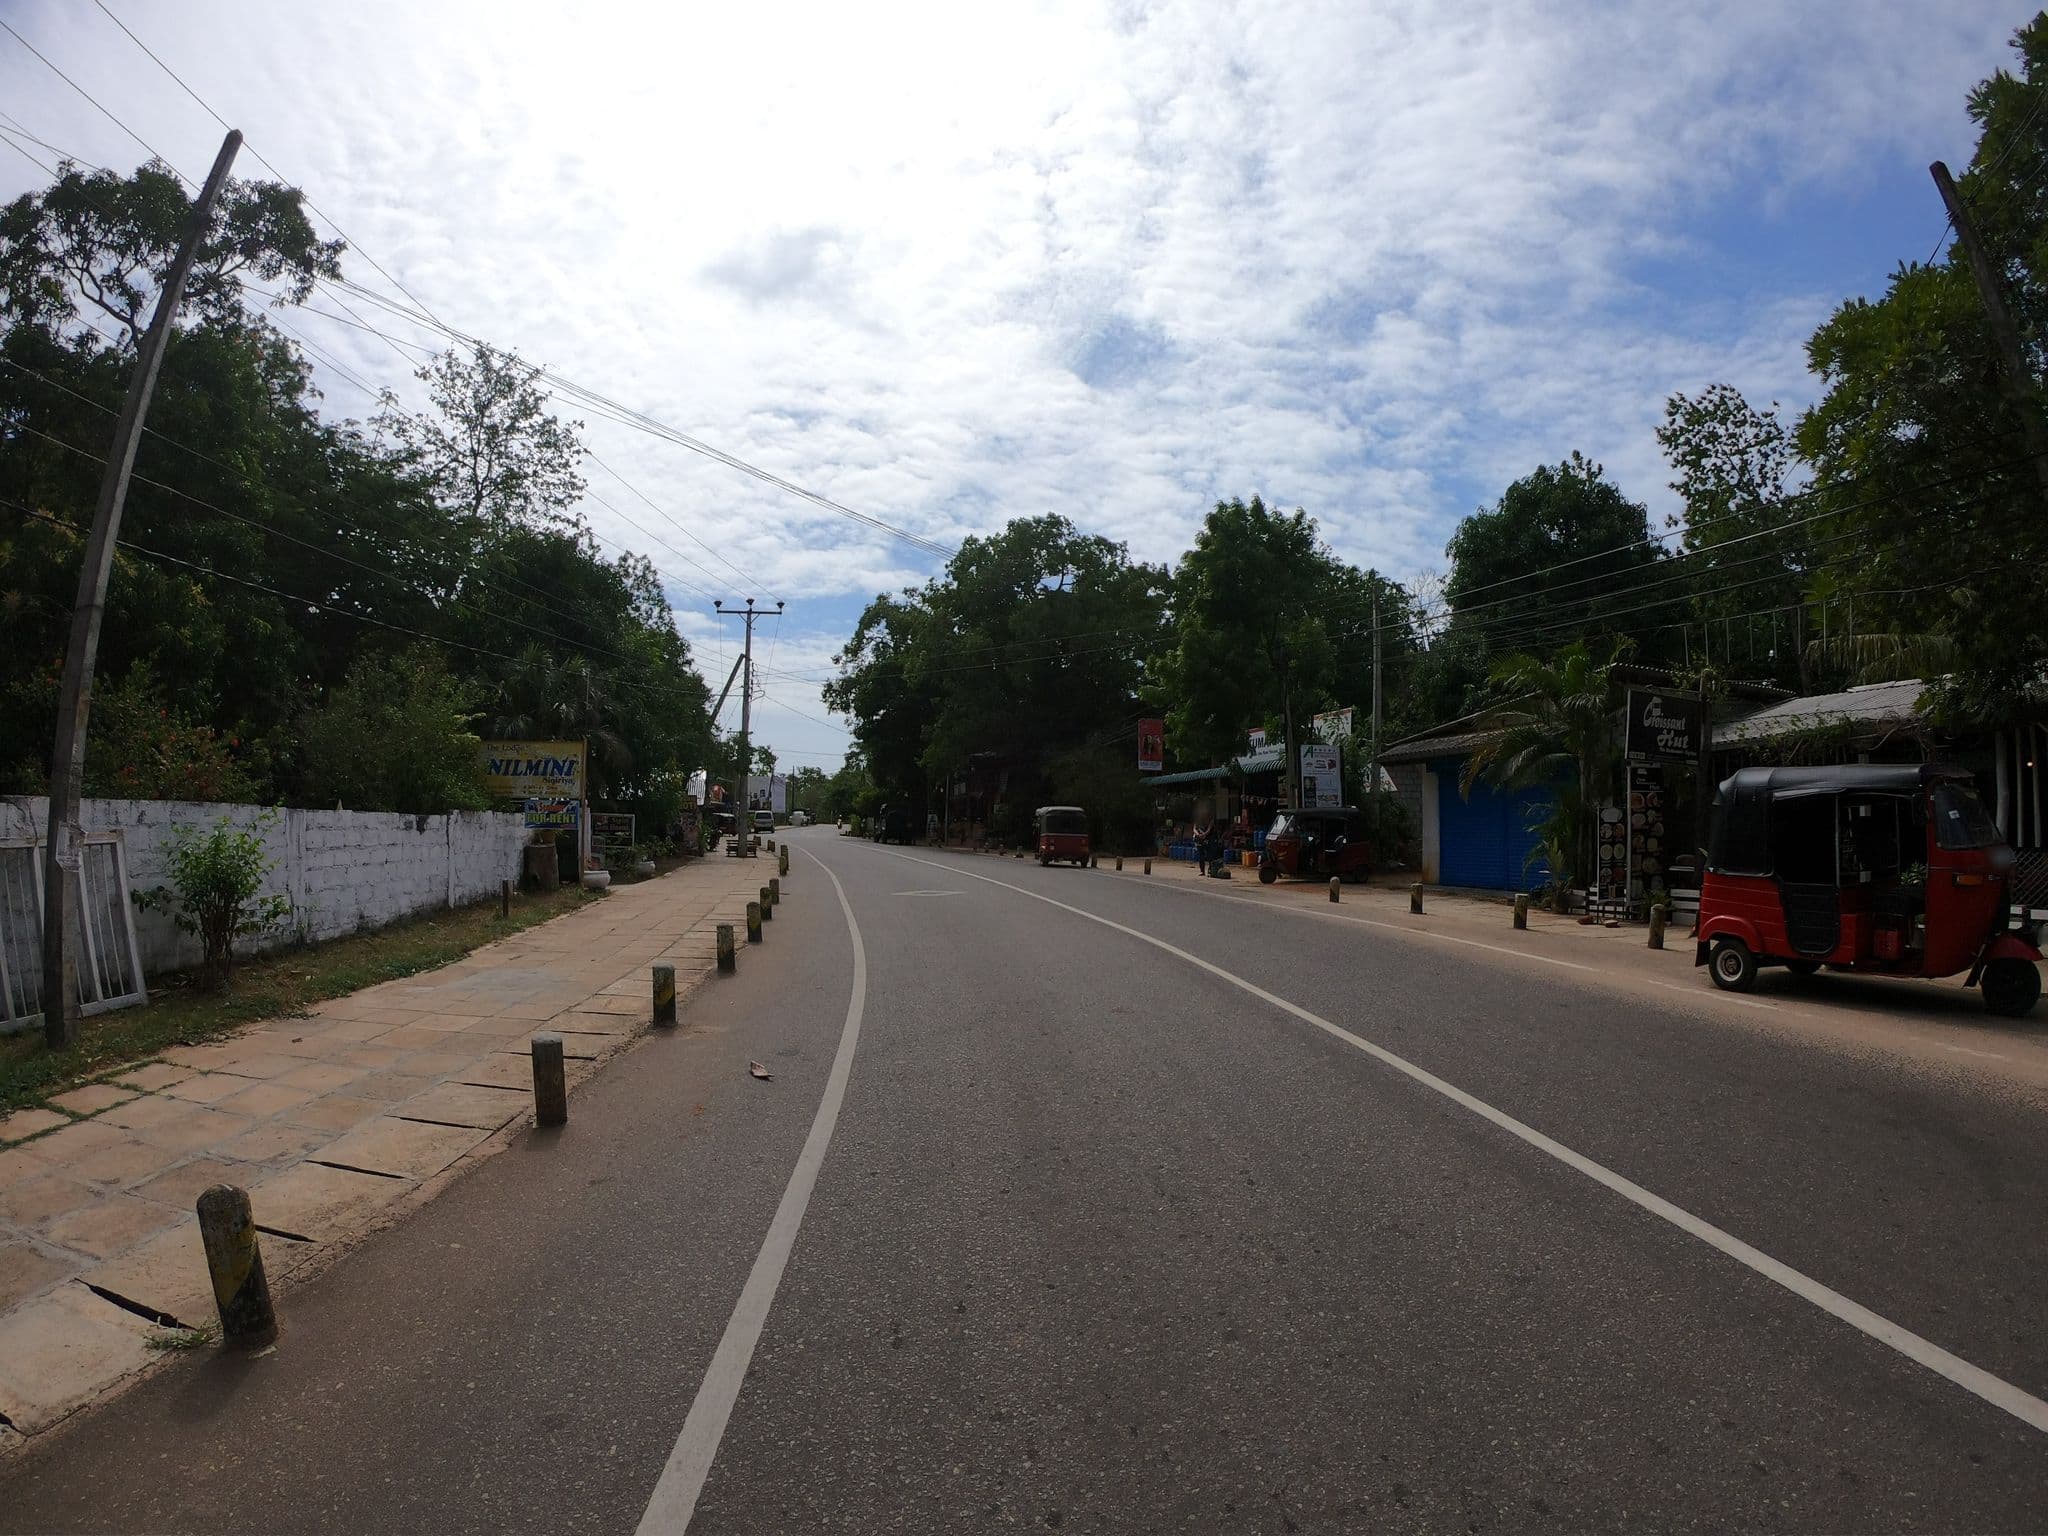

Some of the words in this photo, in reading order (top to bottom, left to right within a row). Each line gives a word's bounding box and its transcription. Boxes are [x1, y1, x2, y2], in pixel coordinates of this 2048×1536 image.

[1657, 729, 1689, 749] Hut
[487, 757, 577, 776] NILMINI
[528, 813, 546, 824] FOR
[550, 813, 576, 824] RENT
